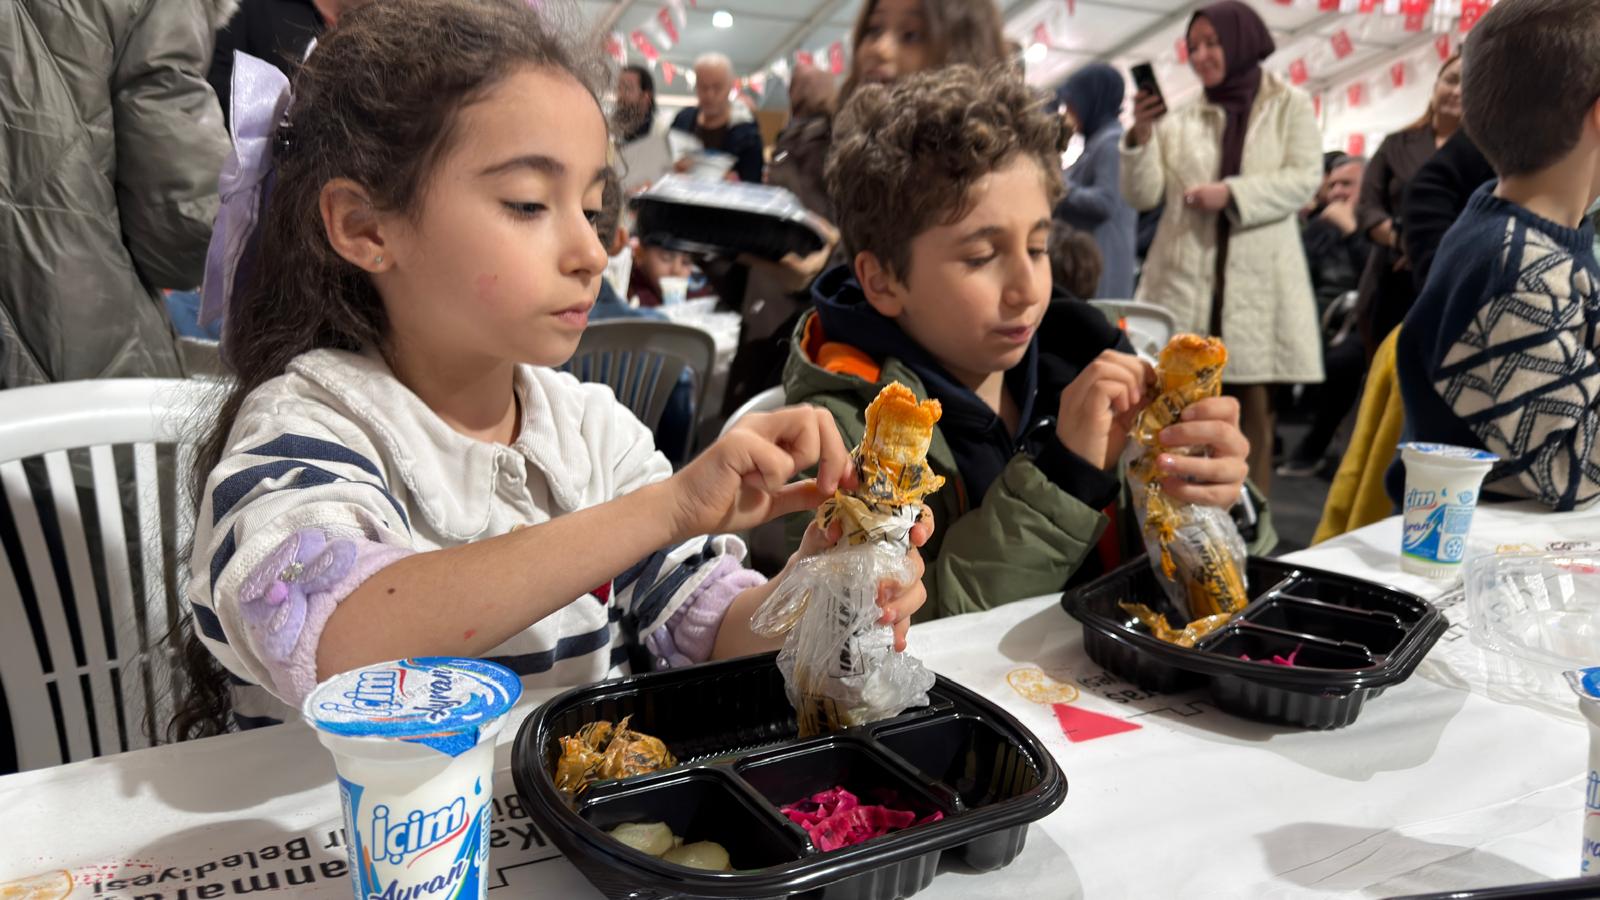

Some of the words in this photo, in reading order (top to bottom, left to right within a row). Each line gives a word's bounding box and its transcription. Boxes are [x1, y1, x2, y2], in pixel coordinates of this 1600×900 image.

[413, 668, 462, 720] Ayran
[372, 796, 465, 865] İçim
[93, 836, 312, 898] Belediyesi
